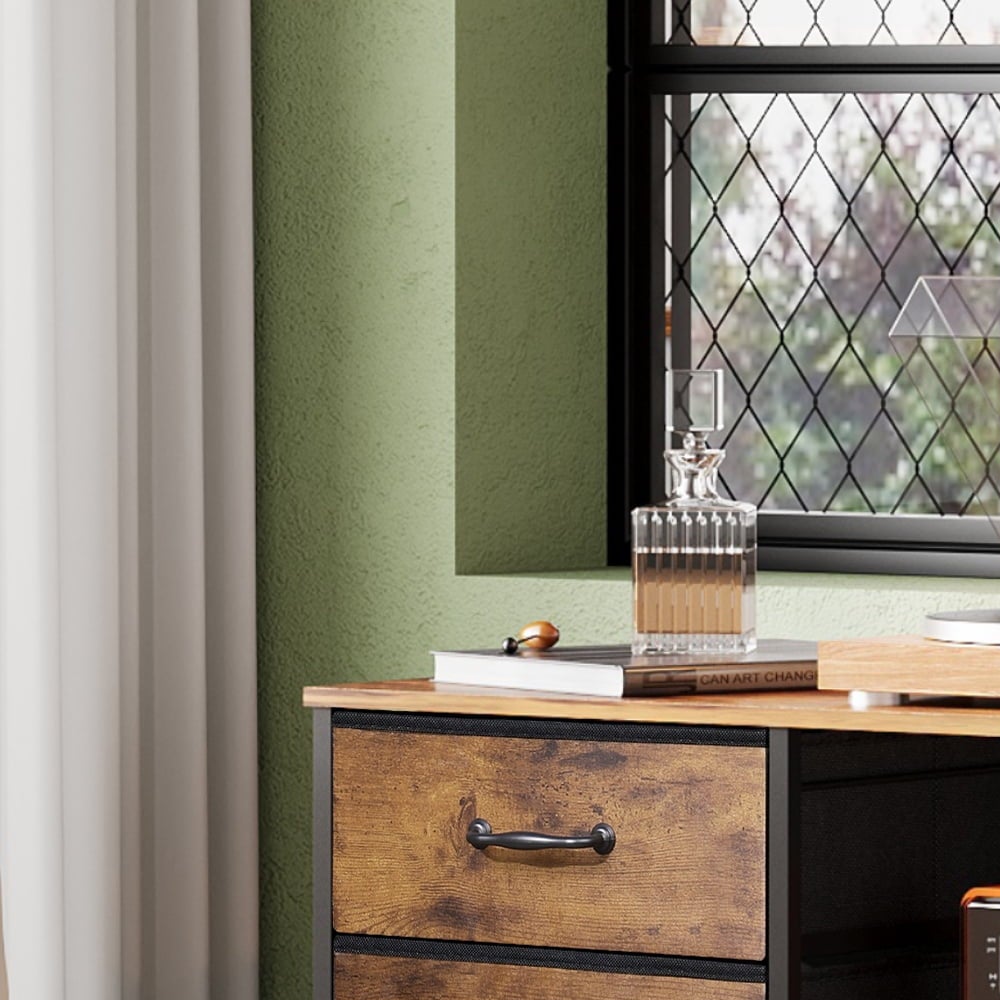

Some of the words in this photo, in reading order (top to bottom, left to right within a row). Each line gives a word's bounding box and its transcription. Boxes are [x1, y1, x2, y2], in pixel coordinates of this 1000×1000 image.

[700, 674, 729, 686] CAN
[733, 673, 760, 684] ART
[764, 670, 818, 683] CHANG
